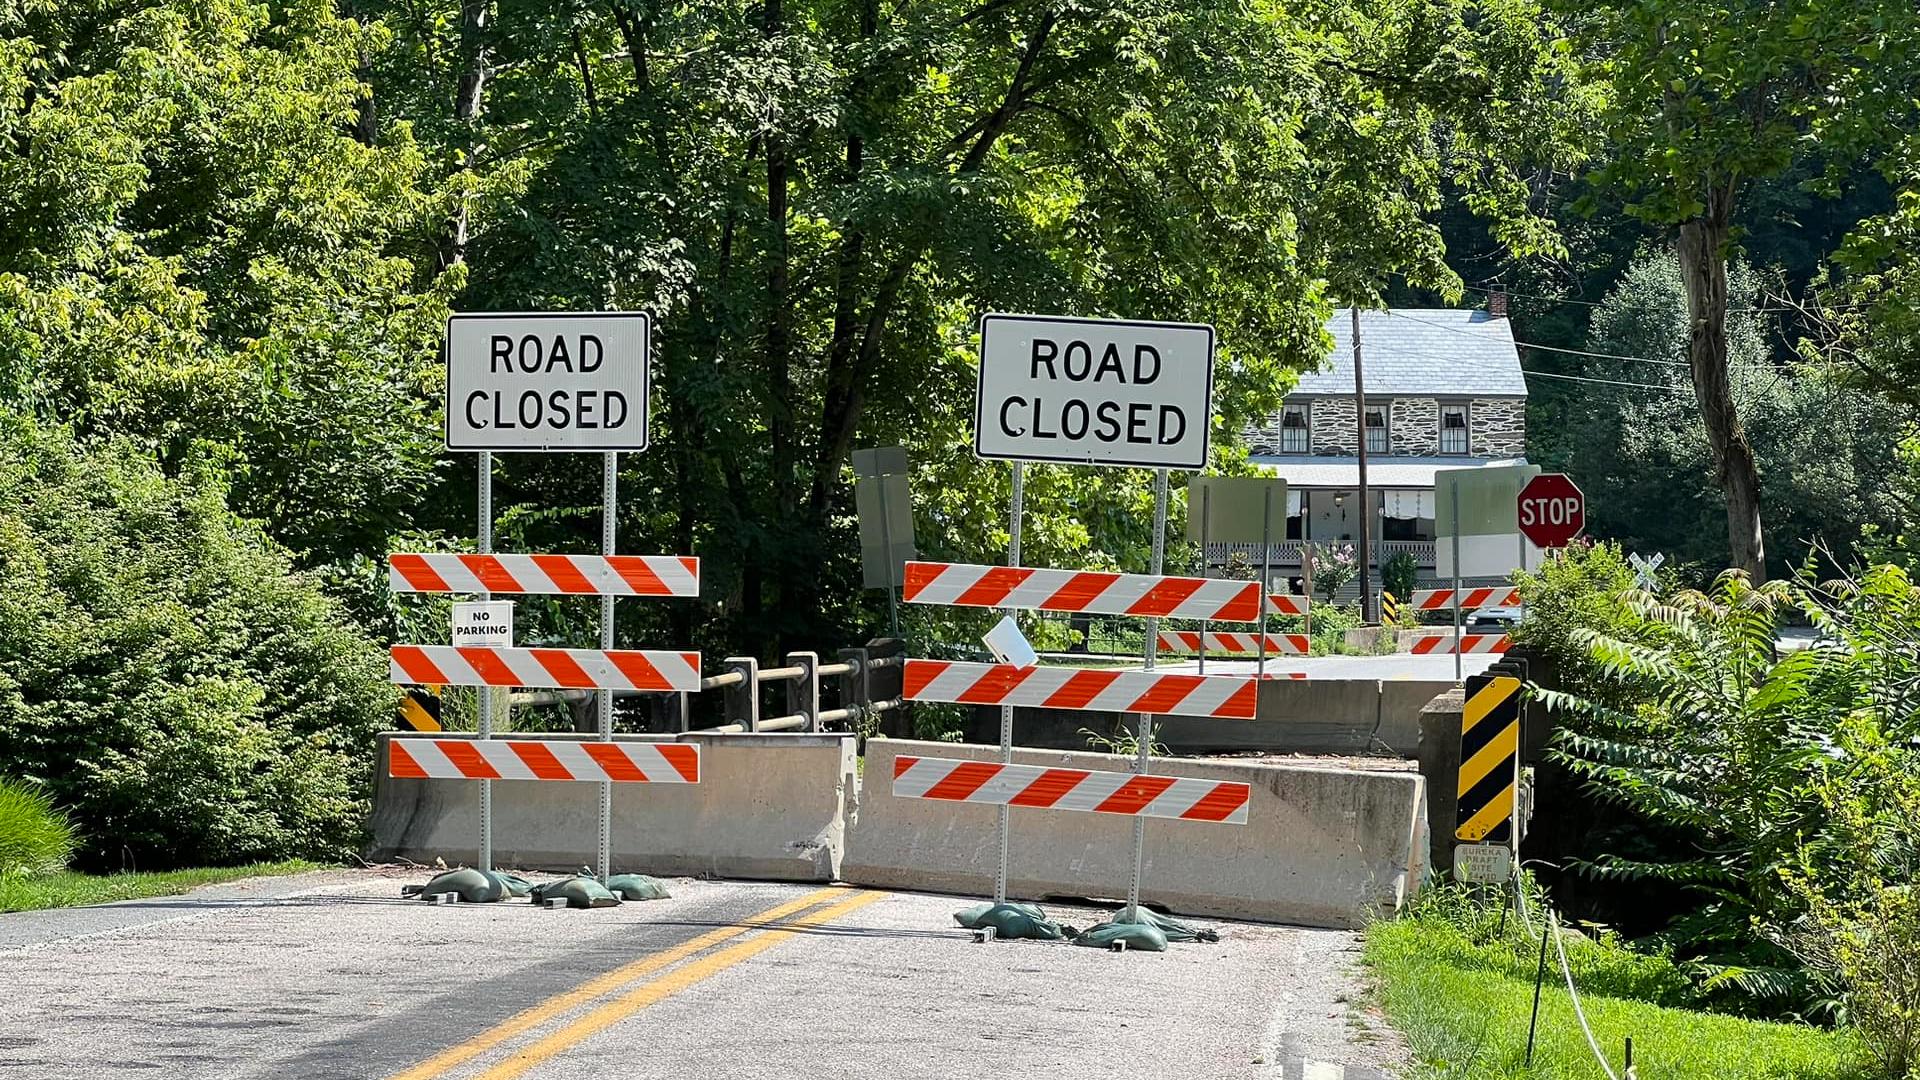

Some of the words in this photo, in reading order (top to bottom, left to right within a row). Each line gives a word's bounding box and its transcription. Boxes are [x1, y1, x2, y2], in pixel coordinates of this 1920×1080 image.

[490, 334, 604, 374] ROAD
[1030, 338, 1162, 385] ROAD
[465, 390, 628, 430] CLOSED
[999, 395, 1187, 446] CLOSED
[1521, 497, 1580, 526] STOP
[456, 625, 508, 636] PARKING
[472, 611, 490, 621] NO
[1462, 847, 1502, 856] EUREKA
[1471, 863, 1492, 872] SITE
